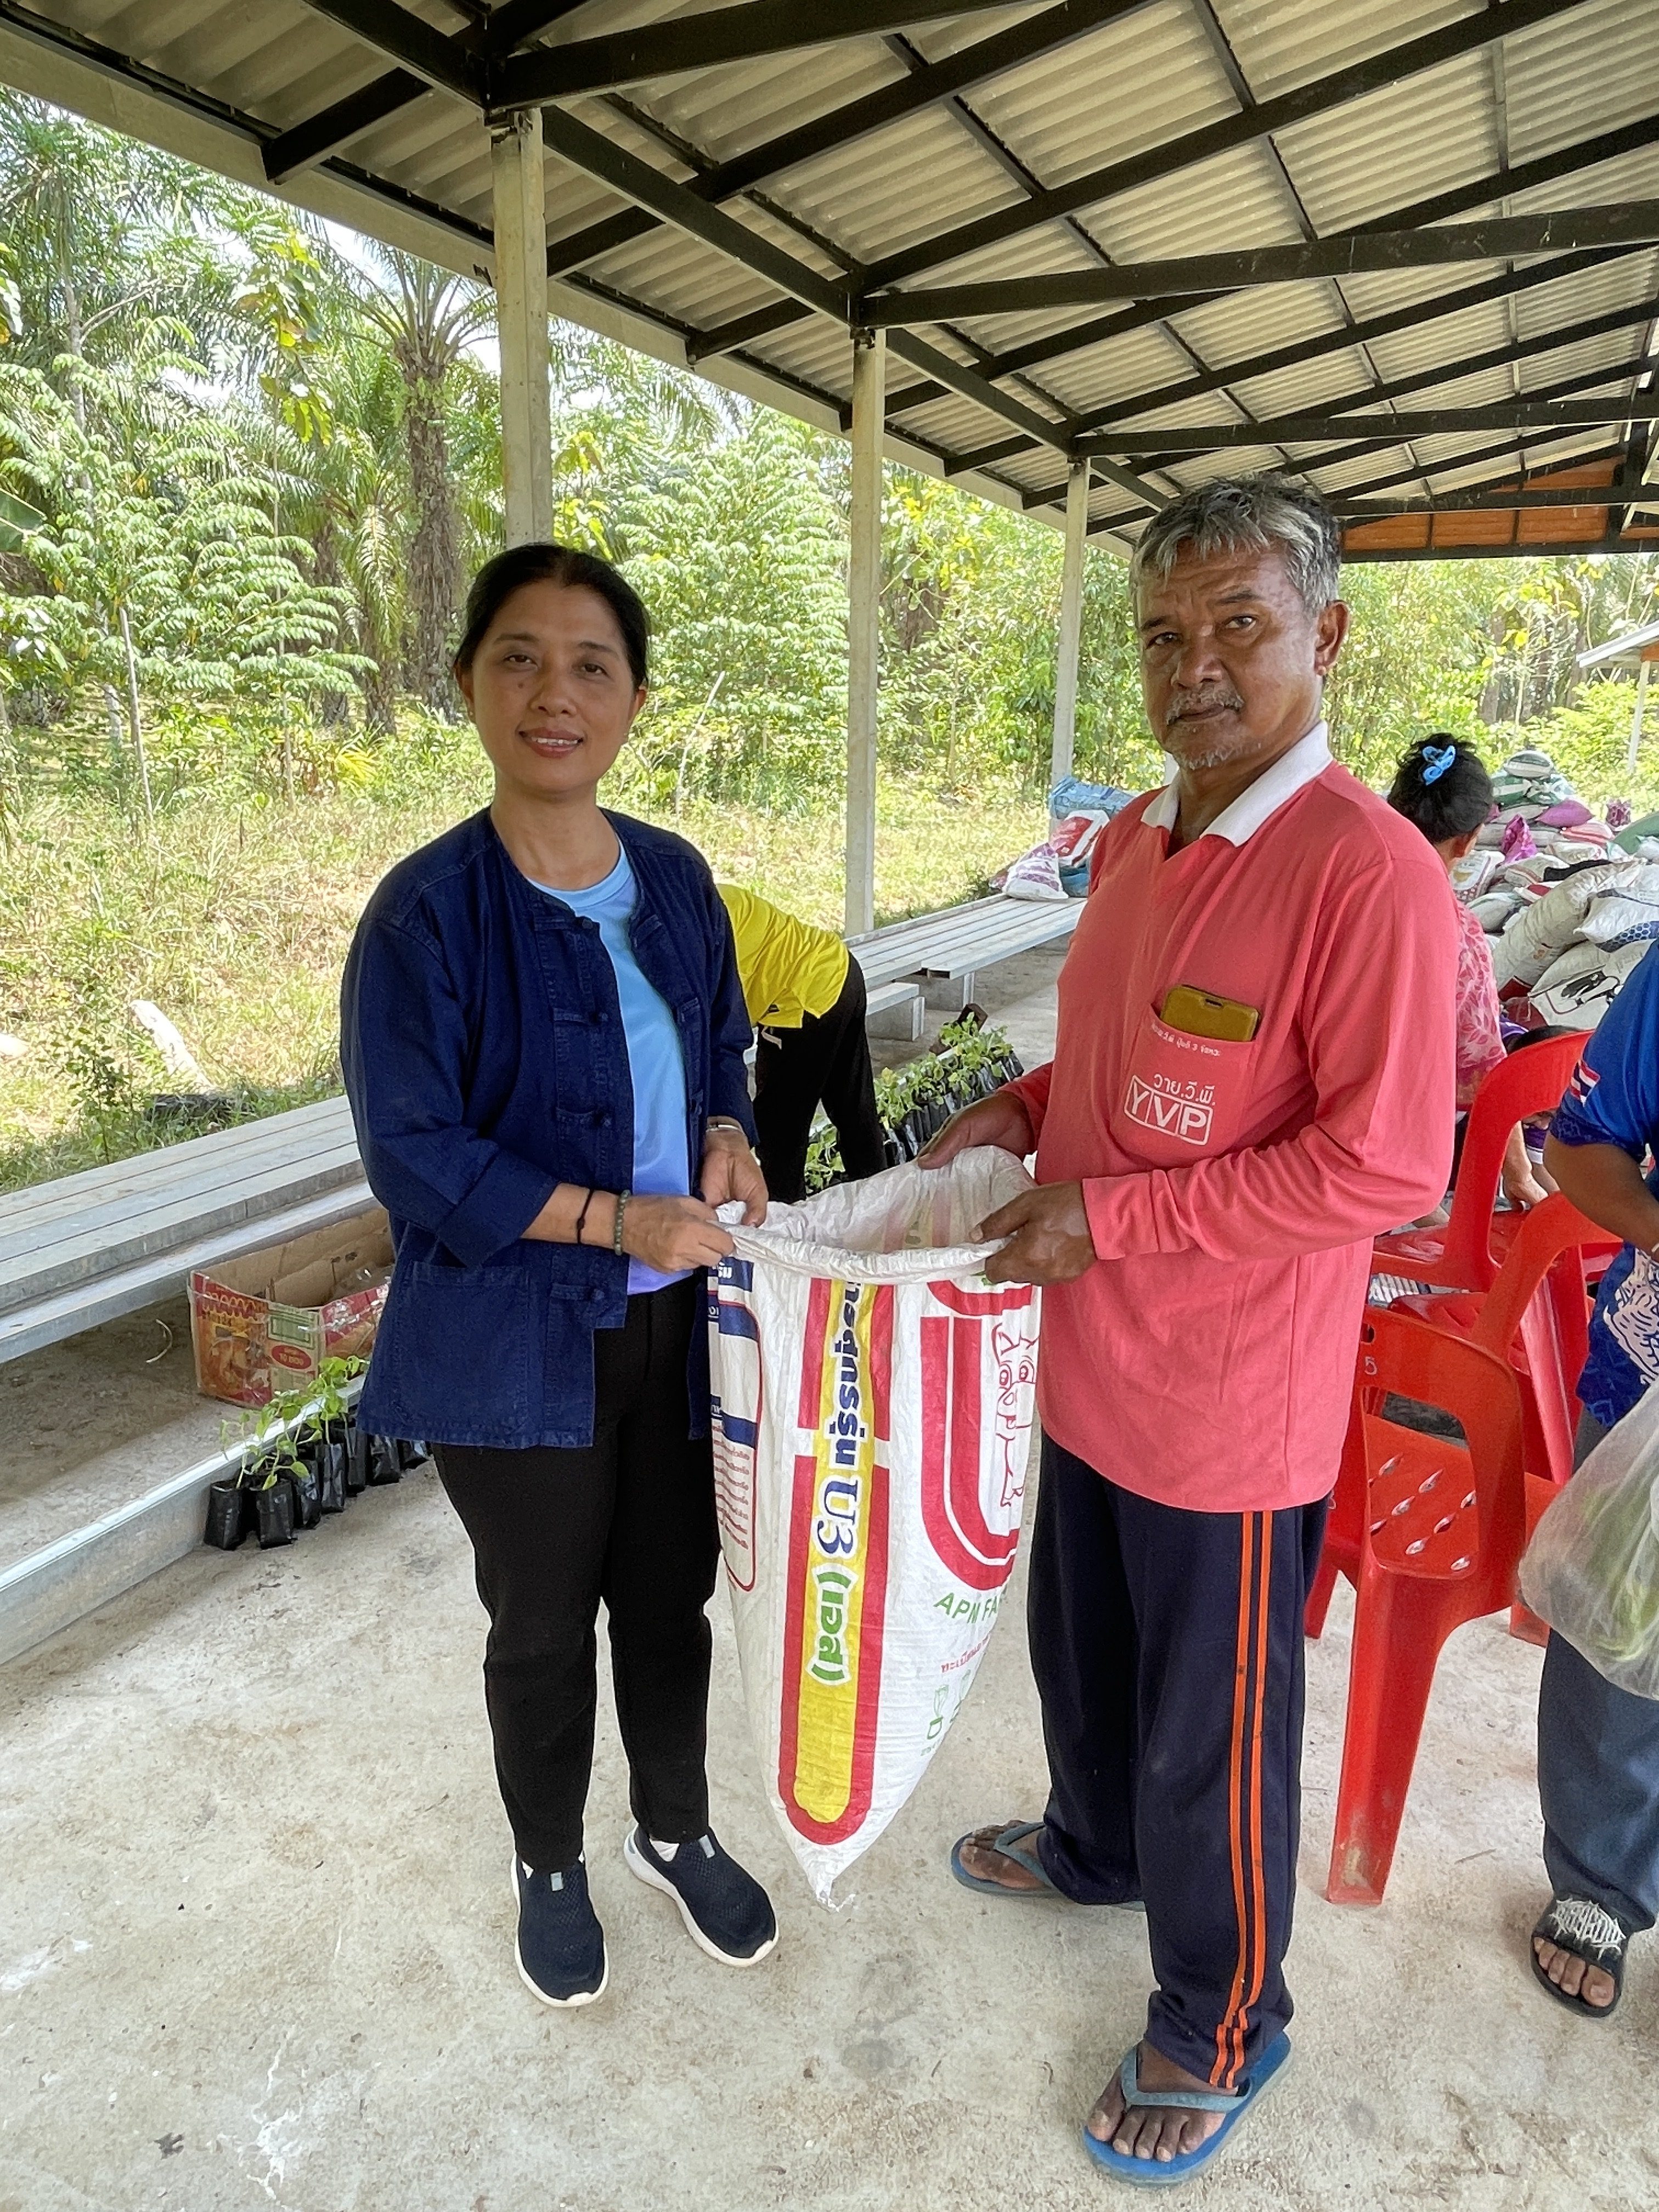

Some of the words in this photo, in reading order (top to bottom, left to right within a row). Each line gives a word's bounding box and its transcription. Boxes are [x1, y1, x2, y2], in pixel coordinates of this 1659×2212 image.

[1131, 1081, 1207, 1135] YVP
[1364, 1356, 1378, 1375] 5
[816, 1480, 859, 1554] U3
[812, 1571, 850, 1682] (เอส)
